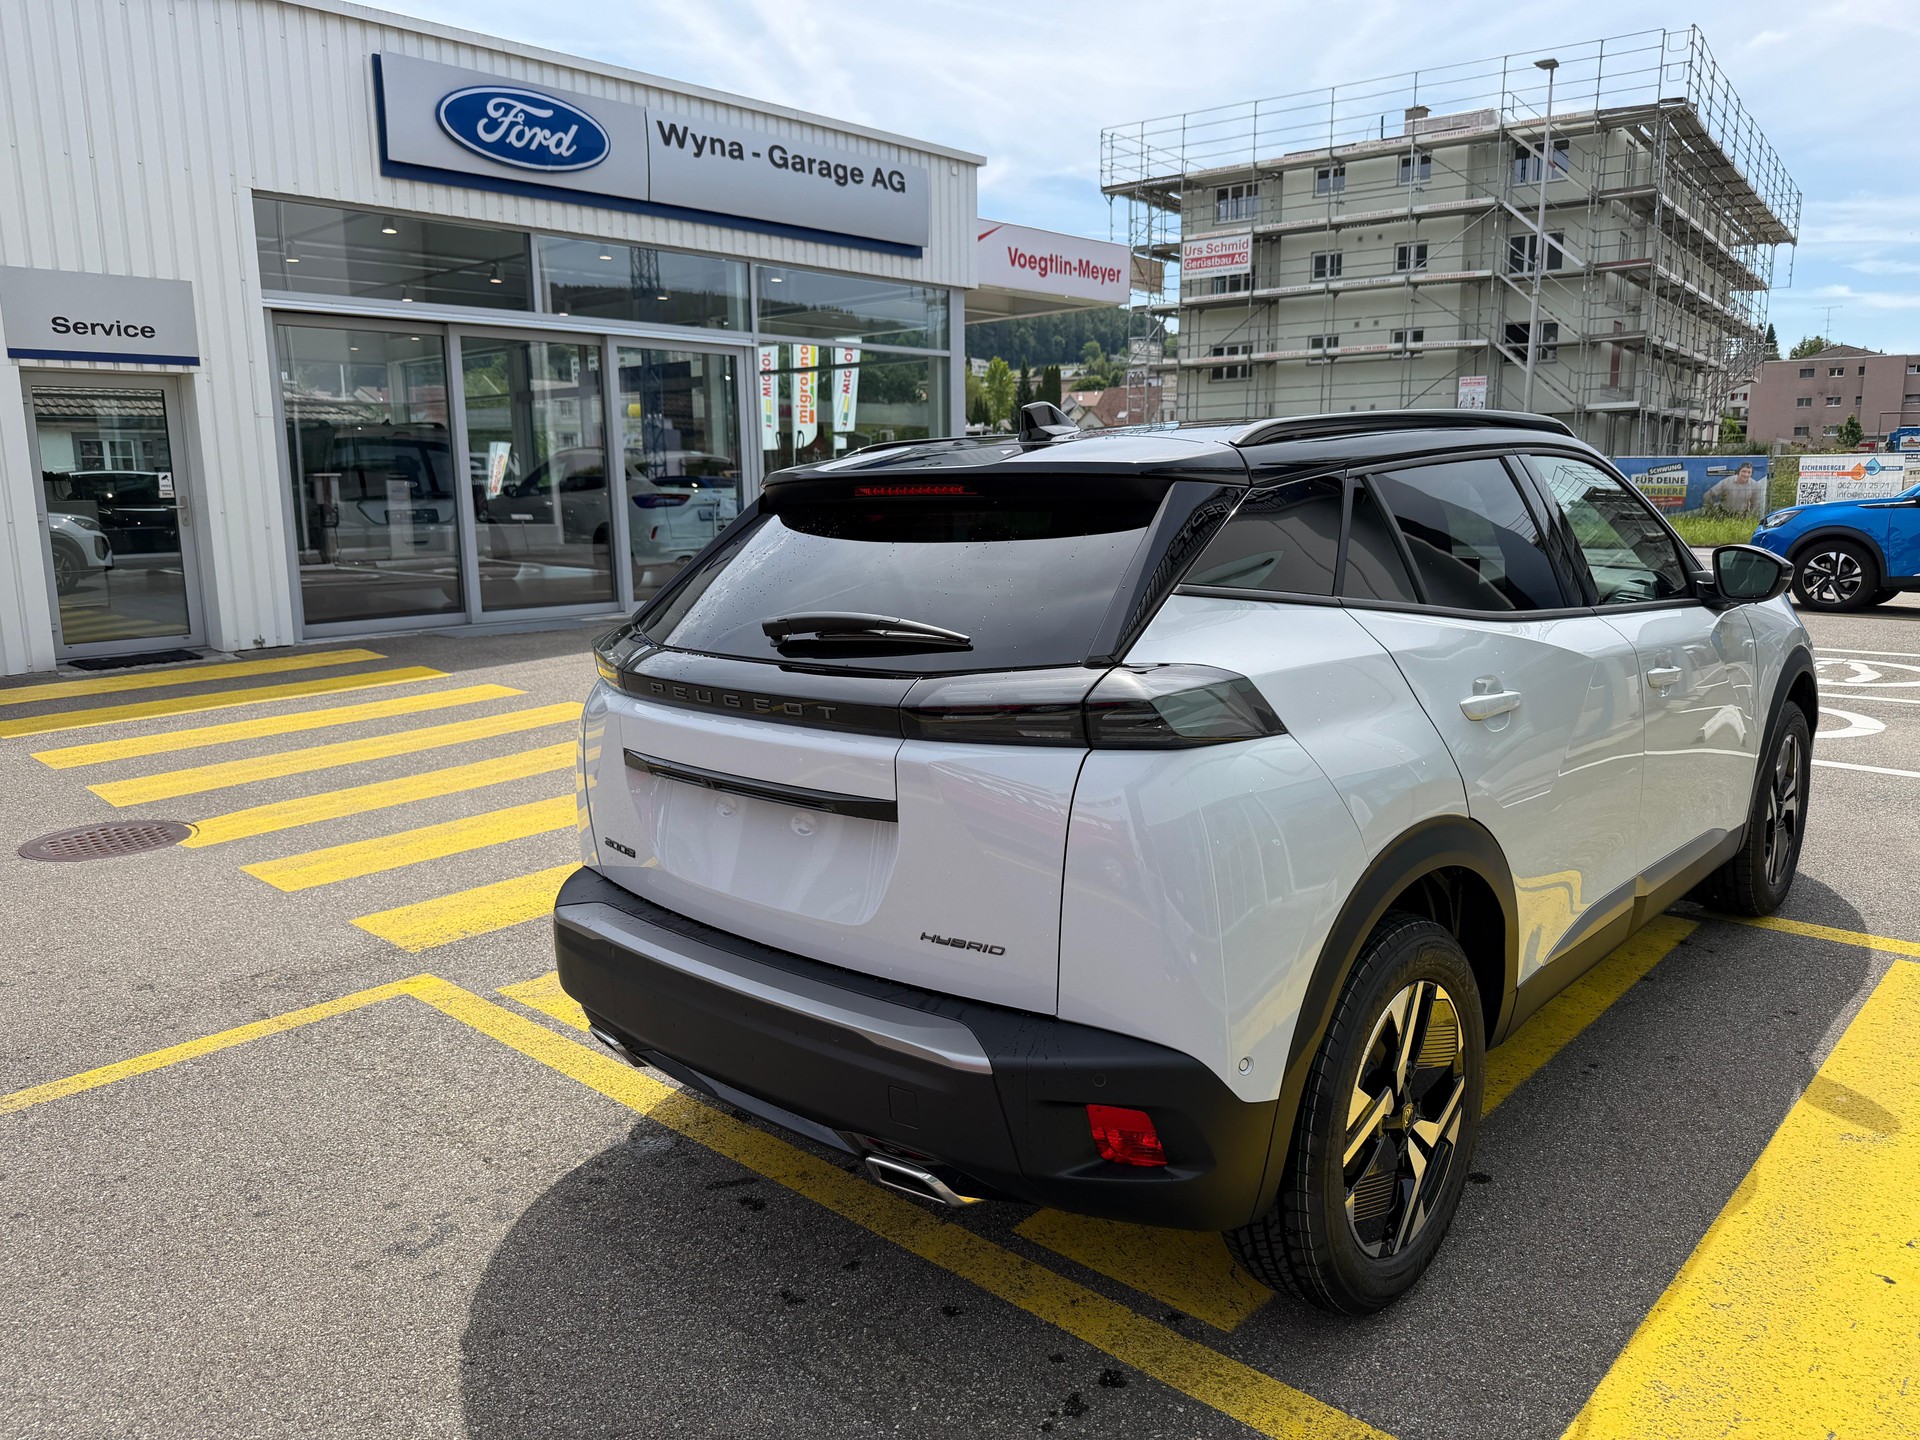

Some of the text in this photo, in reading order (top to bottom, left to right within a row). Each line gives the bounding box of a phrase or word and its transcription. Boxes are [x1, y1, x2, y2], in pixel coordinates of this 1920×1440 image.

[476, 97, 579, 157] Ford
[656, 120, 745, 159] Wyna
[767, 144, 864, 188] Garage
[871, 167, 906, 194] AG
[1184, 239, 1249, 257] Urs Schmid
[1007, 246, 1122, 285] Voegtlin-Meyer
[1184, 253, 1248, 269] Gerüstbau AG
[51, 316, 156, 339] Service
[1635, 475, 1685, 485] FÜR DEINE
[1650, 463, 1682, 474] SCHWUNG
[650, 682, 837, 720] PEUGEOT
[605, 836, 636, 858] 2008
[920, 931, 1006, 956] HYBRID
